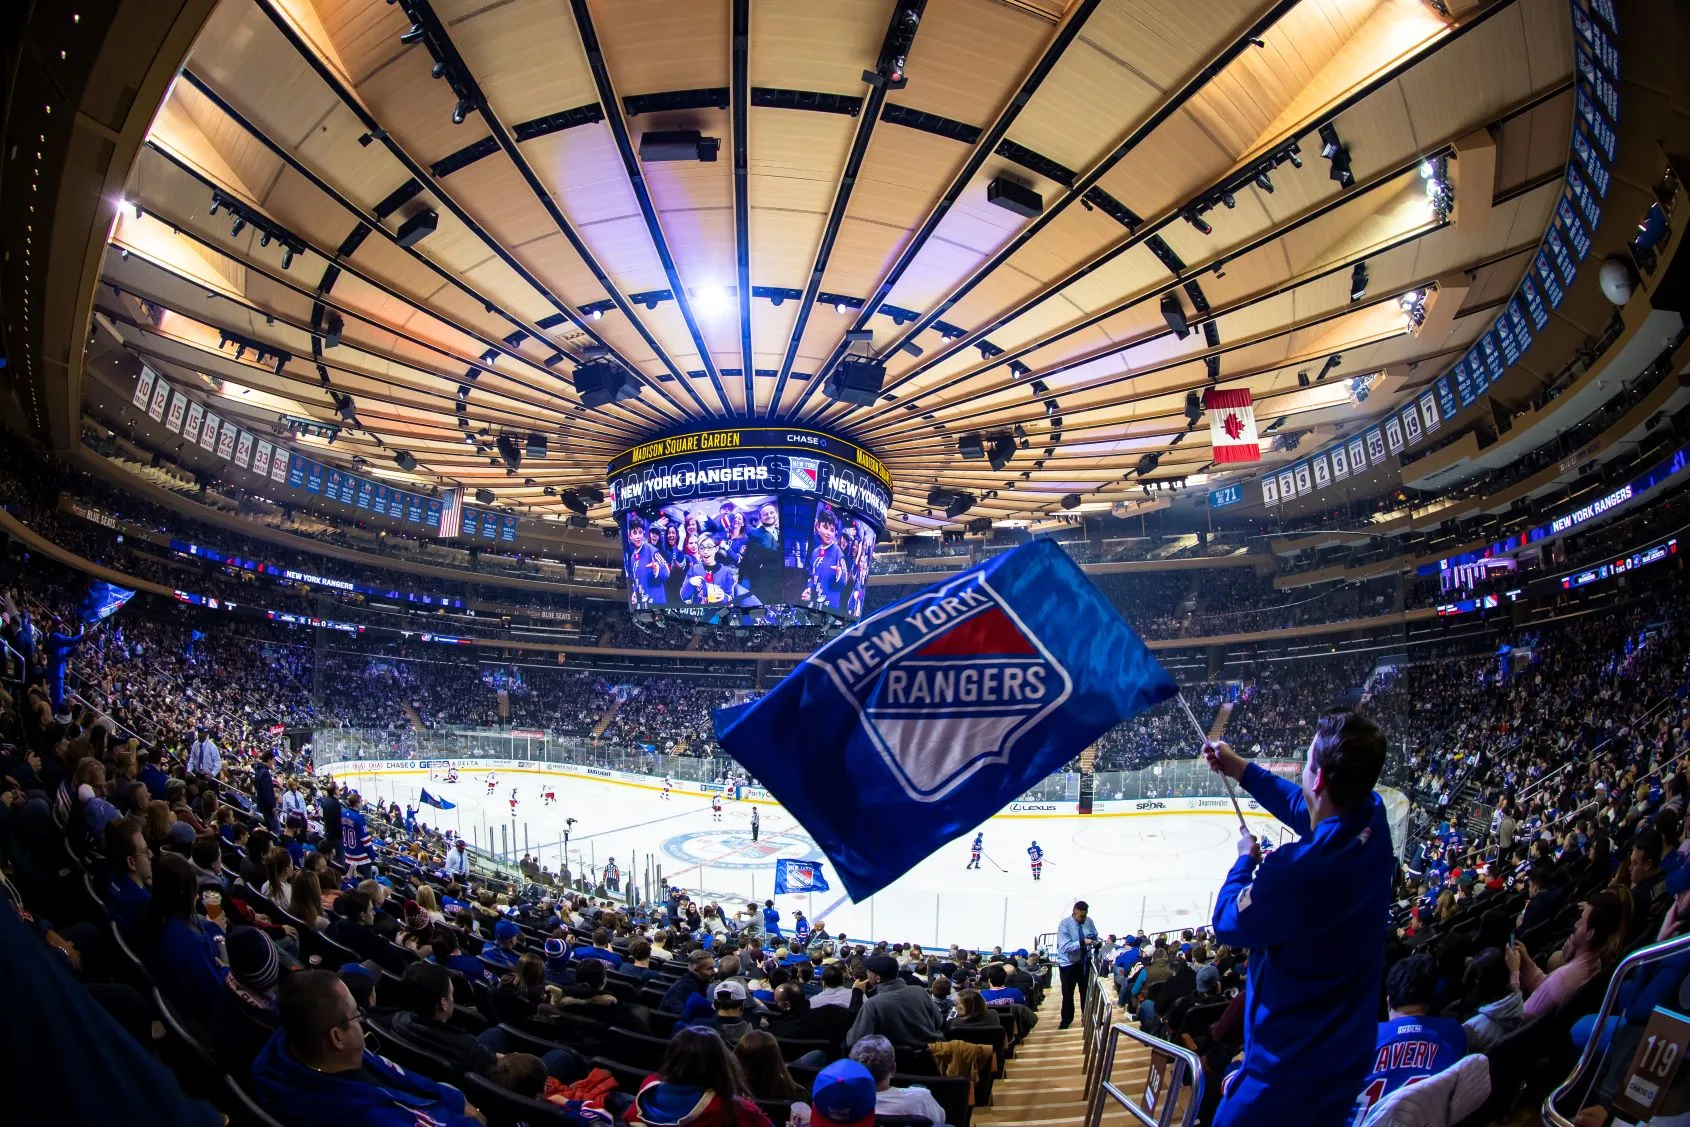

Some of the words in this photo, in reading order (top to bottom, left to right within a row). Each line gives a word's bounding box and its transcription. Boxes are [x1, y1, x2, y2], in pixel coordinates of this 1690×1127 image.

[139, 379, 149, 396] 10
[154, 391, 164, 409] 12
[171, 404, 183, 420] 15
[1426, 404, 1434, 423] 7
[188, 414, 199, 430] 15
[1406, 416, 1419, 437] 19
[205, 423, 215, 439] 19
[787, 434, 819, 445] CHASE
[1389, 429, 1400, 446] 11
[220, 432, 233, 449] 22
[238, 441, 250, 457] 24
[632, 443, 663, 462] MADISON
[665, 436, 698, 454] SQUARE
[701, 432, 740, 448] GARDEN
[1369, 440, 1383, 458] 35
[257, 450, 269, 465] 33
[273, 457, 287, 472] 613
[1336, 458, 1343, 472] 9
[1352, 450, 1364, 466] 11
[1299, 473, 1306, 488] 9
[1318, 466, 1326, 480] 2
[621, 482, 643, 500] NEW
[645, 473, 682, 492] YORK
[686, 466, 768, 486] RANGERS
[1284, 480, 1291, 494] 3
[828, 475, 858, 497] NEW
[859, 487, 880, 511] YORK
[1225, 487, 1236, 501] 71
[1267, 486, 1273, 500] 1
[1552, 515, 1572, 532] NEW
[1572, 504, 1594, 524] YORK
[1594, 485, 1632, 514] RANGERS
[86, 509, 100, 523] BLUE
[100, 516, 116, 529] SEATS
[286, 571, 303, 580] NEW
[303, 574, 321, 584] YORK
[321, 578, 354, 590] RANGERS
[555, 612, 571, 620] SEATS
[837, 626, 904, 683] NEW
[905, 586, 988, 633] YORK
[888, 666, 1047, 704] RANGERS
[597, 769, 611, 777] LIGHT
[1373, 1041, 1439, 1074] AVERY
[1639, 1035, 1679, 1078] 119
[1150, 1064, 1161, 1093] 118
[1629, 1081, 1649, 1098] CHASE
